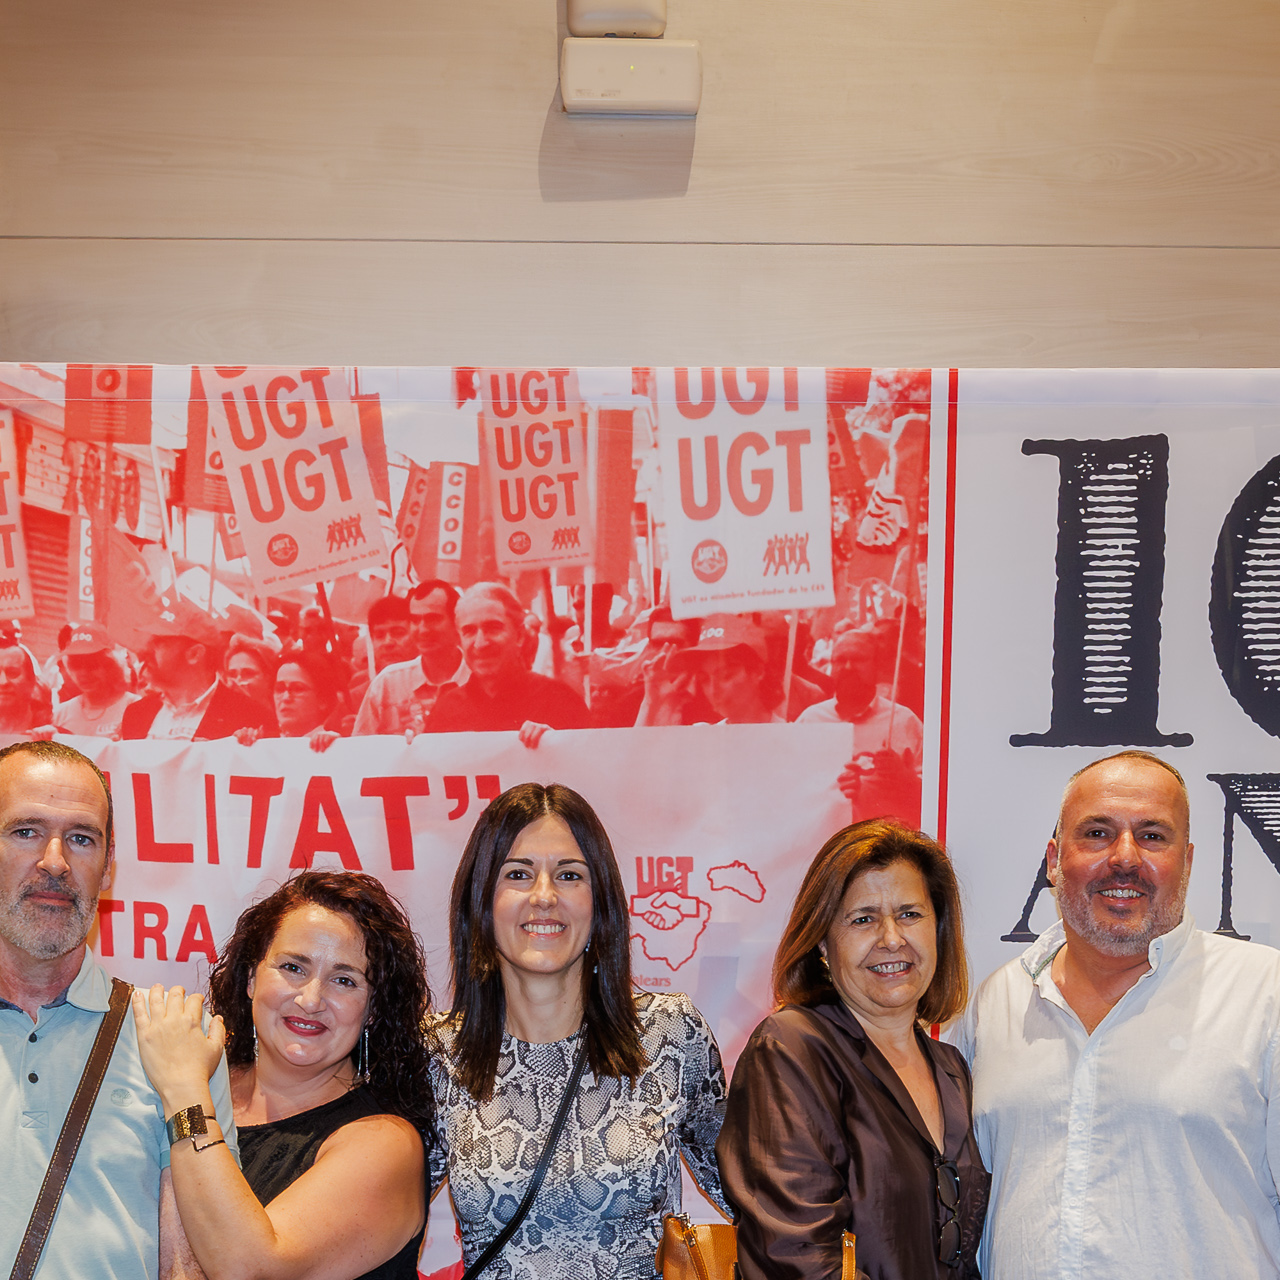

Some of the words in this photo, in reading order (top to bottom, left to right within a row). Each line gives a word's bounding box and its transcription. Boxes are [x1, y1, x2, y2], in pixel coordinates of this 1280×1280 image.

[221, 367, 334, 451] UGT
[490, 368, 570, 418] UGT
[494, 419, 574, 470] UGT
[239, 436, 353, 523] UGT
[499, 472, 579, 523] UGT
[677, 429, 811, 521] UGT
[441, 471, 463, 555] CCOO
[635, 856, 694, 896] UGT
[631, 974, 672, 987] alears
